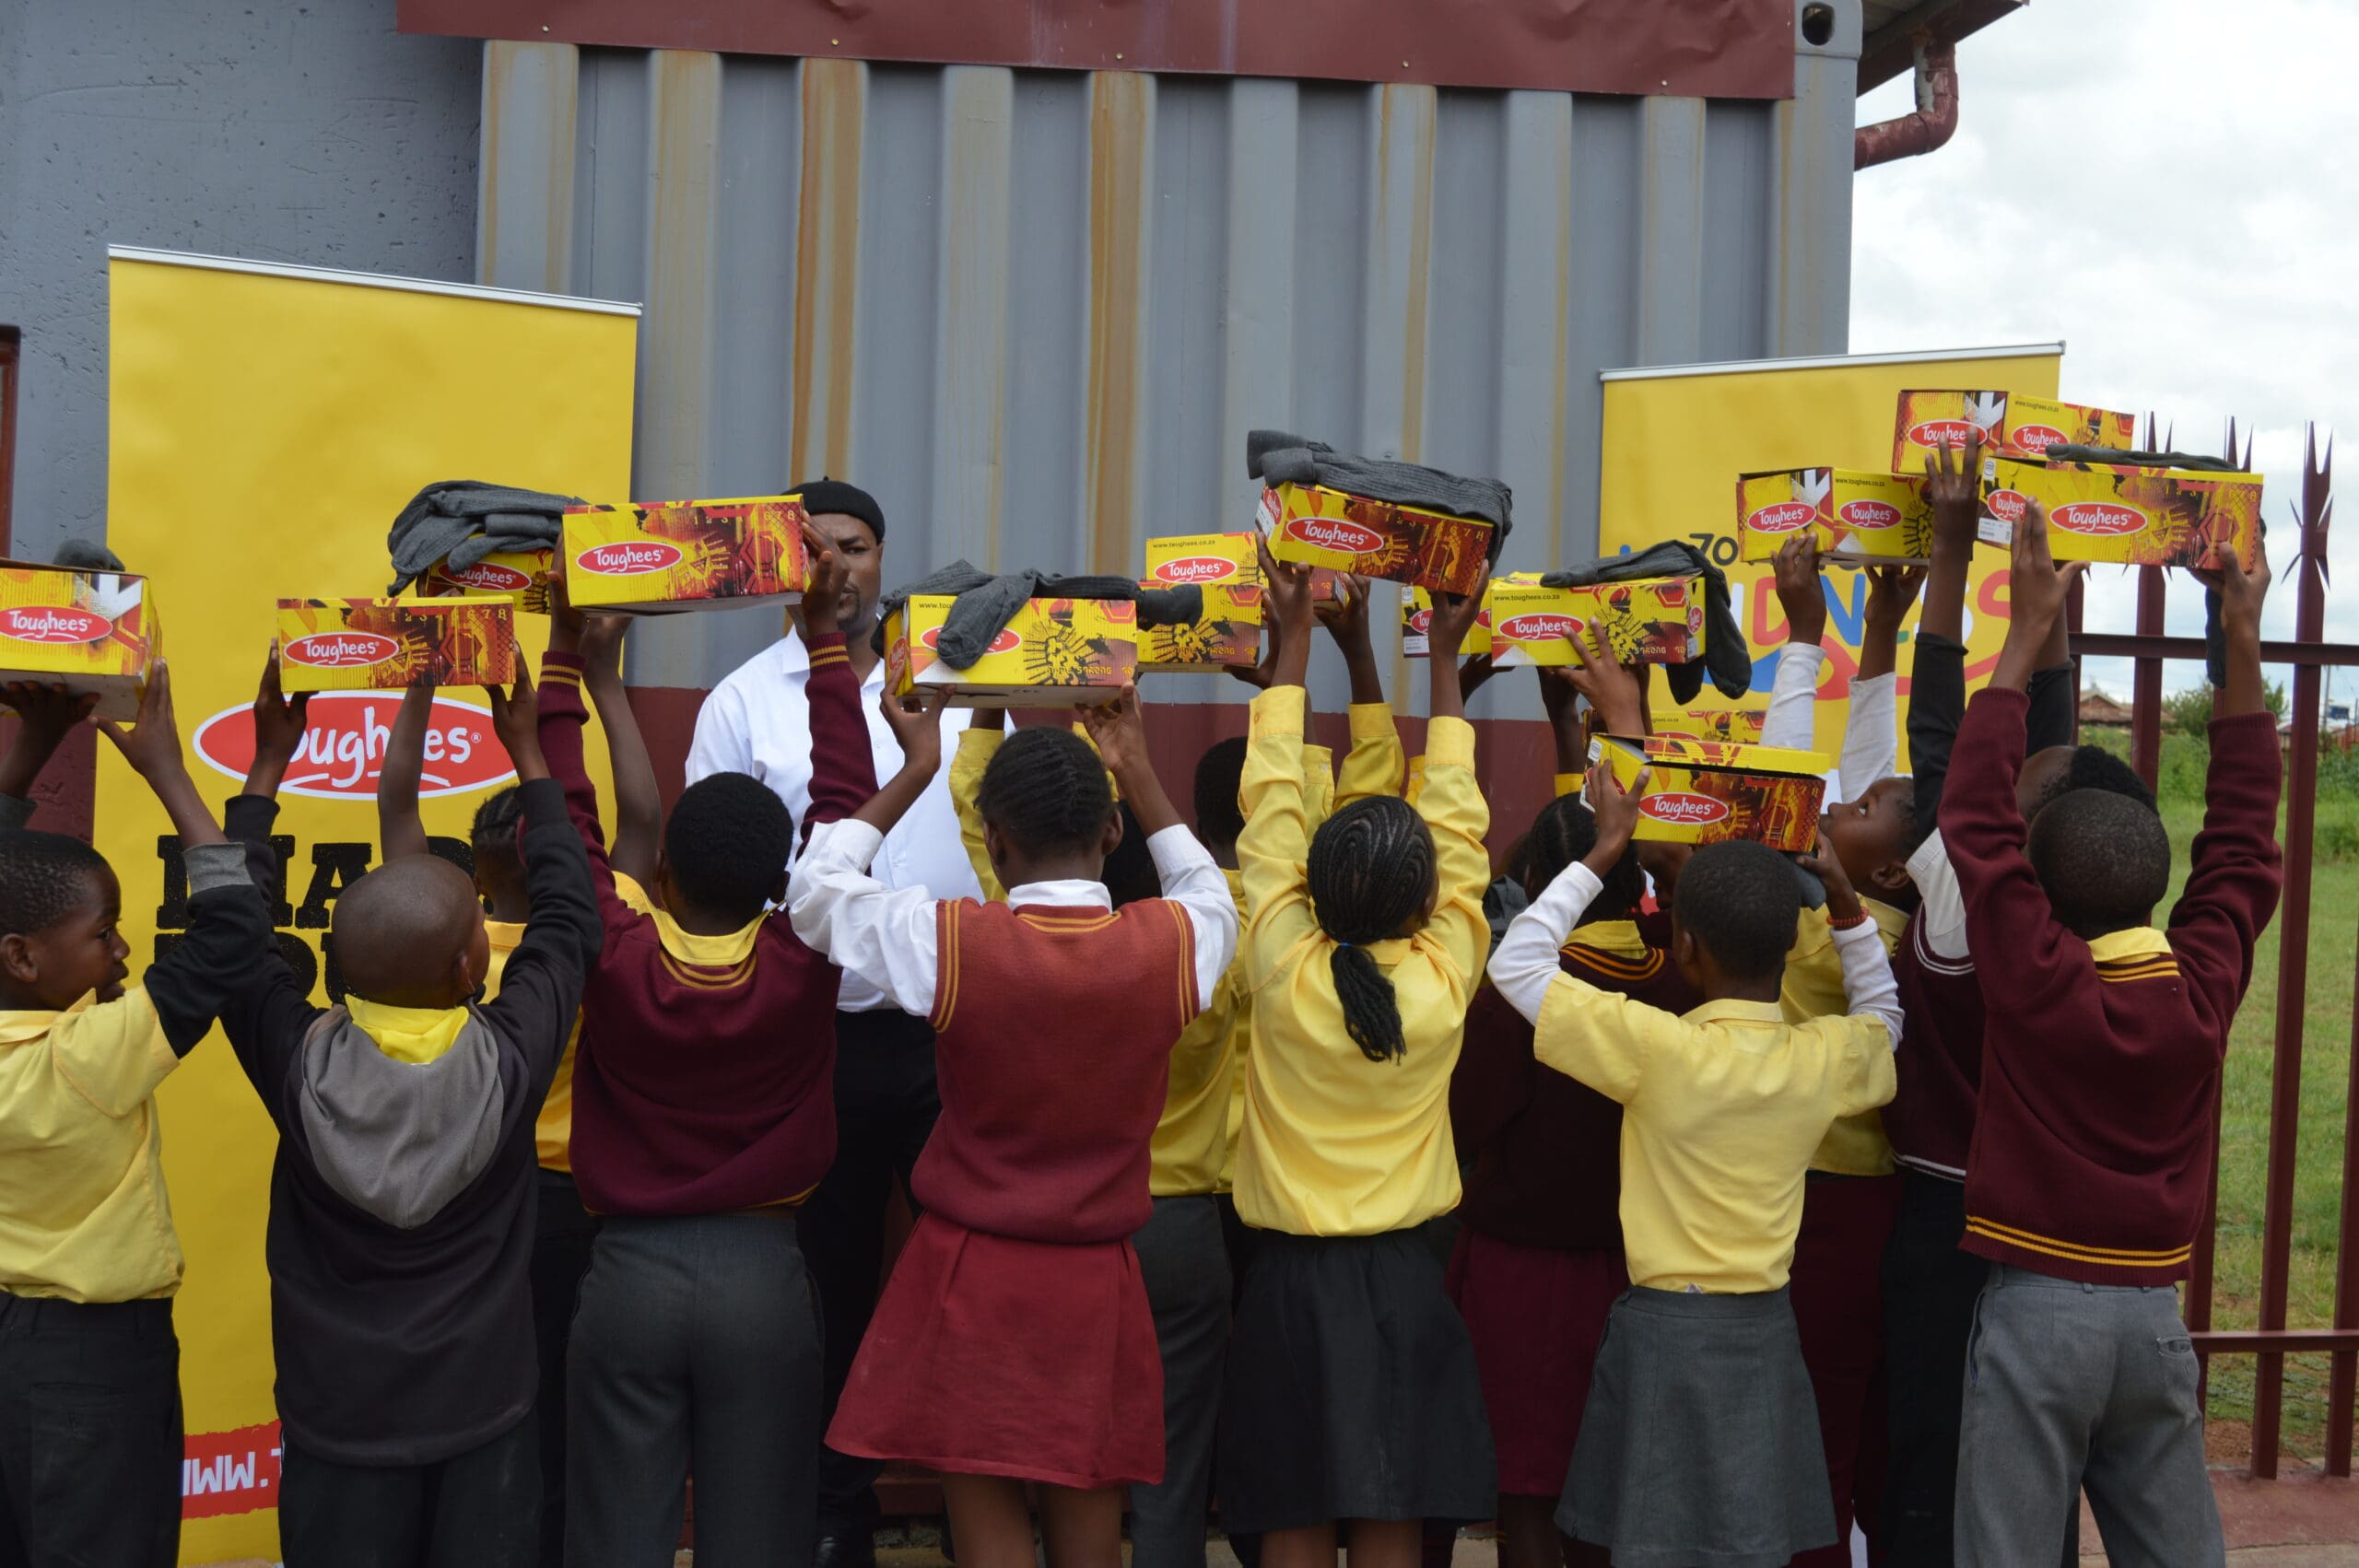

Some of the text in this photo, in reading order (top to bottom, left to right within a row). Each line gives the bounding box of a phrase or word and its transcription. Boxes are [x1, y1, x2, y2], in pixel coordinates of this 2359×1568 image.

[1758, 507, 1804, 530] Toughees
[1849, 503, 1891, 526] Toughees
[2067, 507, 2129, 532] Toughees
[1304, 521, 1366, 546] Toughees
[593, 545, 662, 571] Toughees
[1168, 560, 1221, 581] Toughees
[459, 566, 513, 587] oughees
[9, 610, 88, 638] Toughees
[302, 638, 377, 664] Toughees
[1654, 795, 1711, 820] Toughees
